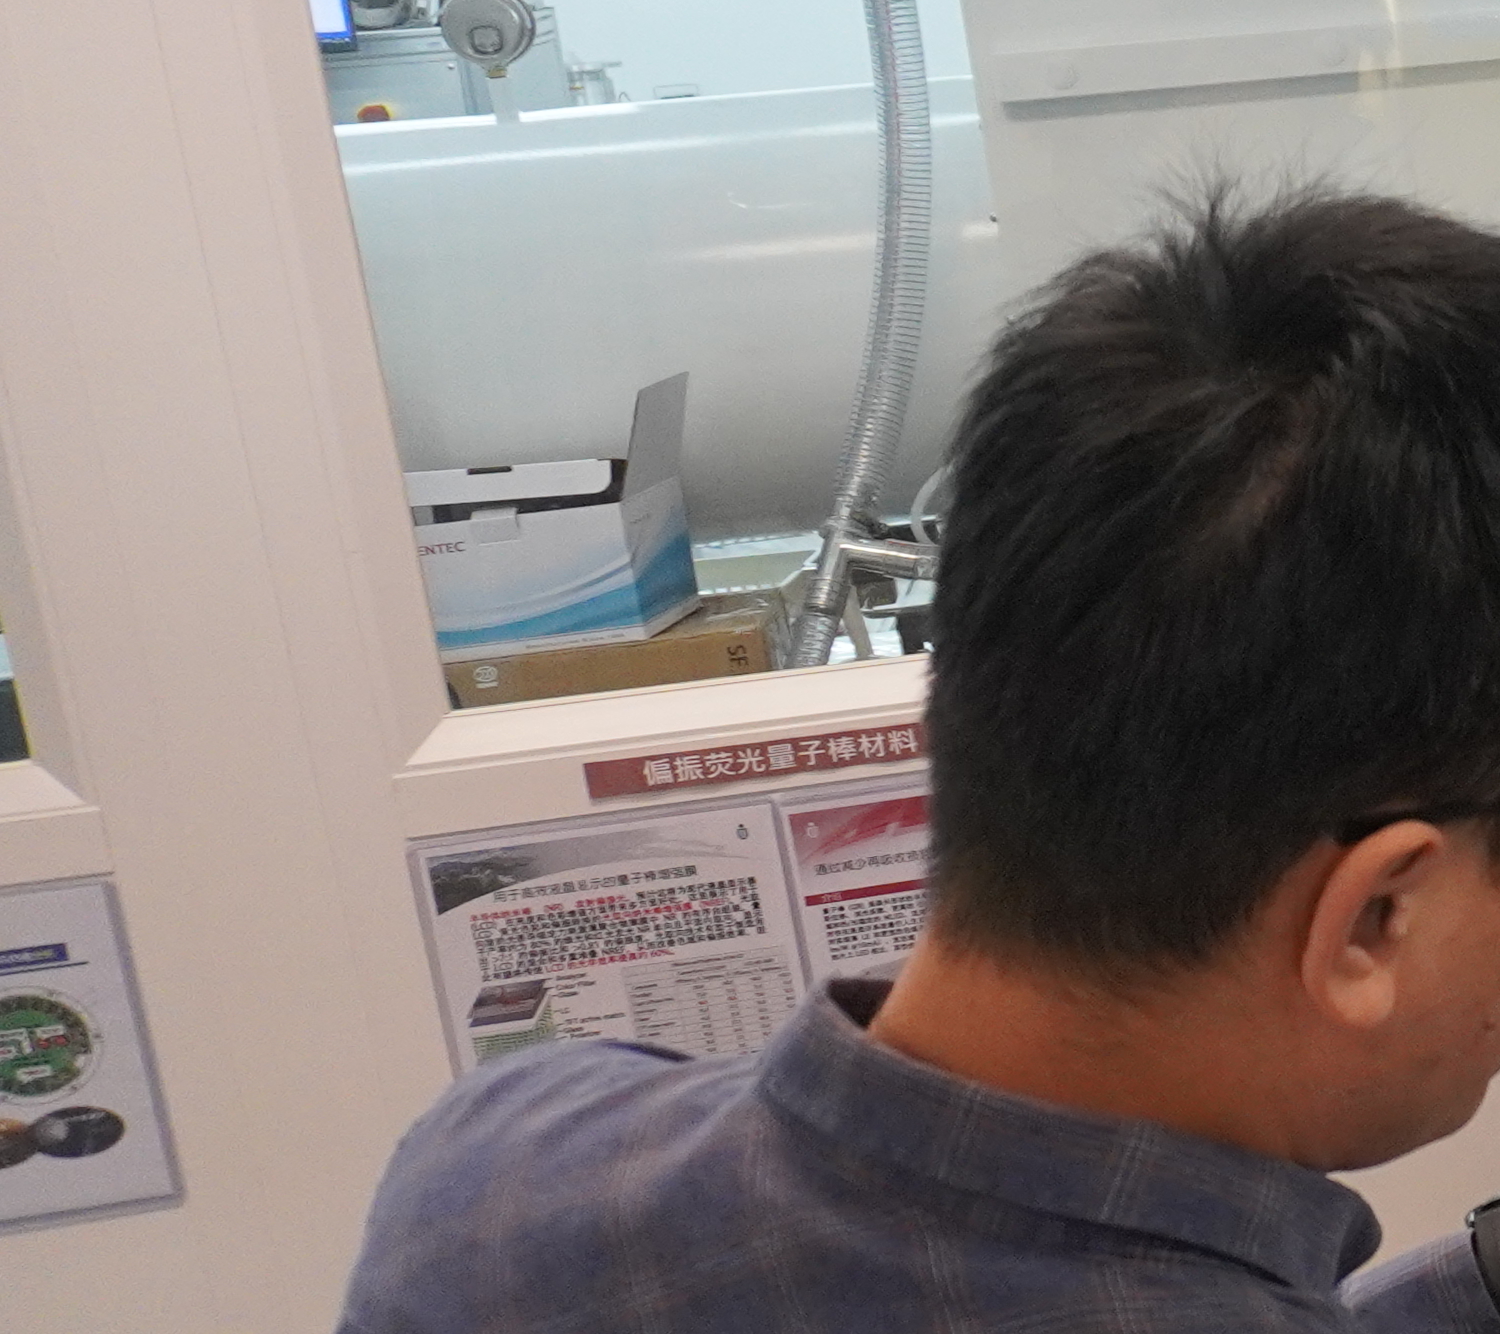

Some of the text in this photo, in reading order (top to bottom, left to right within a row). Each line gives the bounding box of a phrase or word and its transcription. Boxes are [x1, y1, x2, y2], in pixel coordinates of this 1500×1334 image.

[418, 542, 466, 556] ENTEC
[642, 729, 919, 787] 偏振荧光量子棒材料
